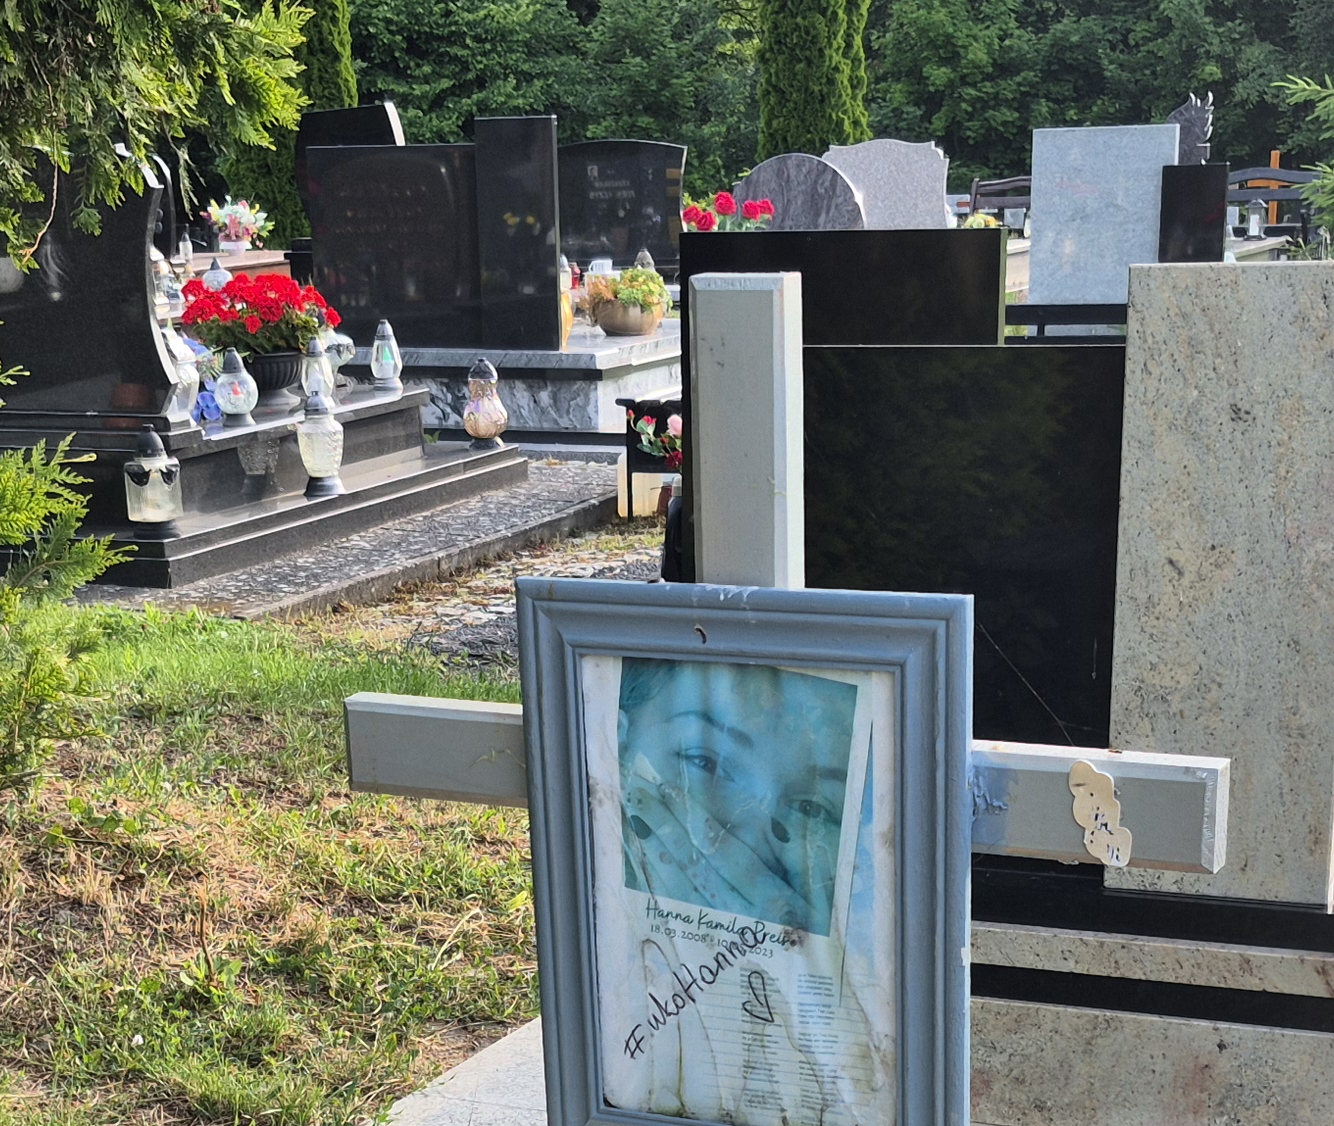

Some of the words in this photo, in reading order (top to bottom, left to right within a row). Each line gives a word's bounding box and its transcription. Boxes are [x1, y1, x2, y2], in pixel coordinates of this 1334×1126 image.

[646, 897, 694, 924] Hanna
[697, 908, 750, 937] Kamila
[717, 937, 773, 959] 10052023
